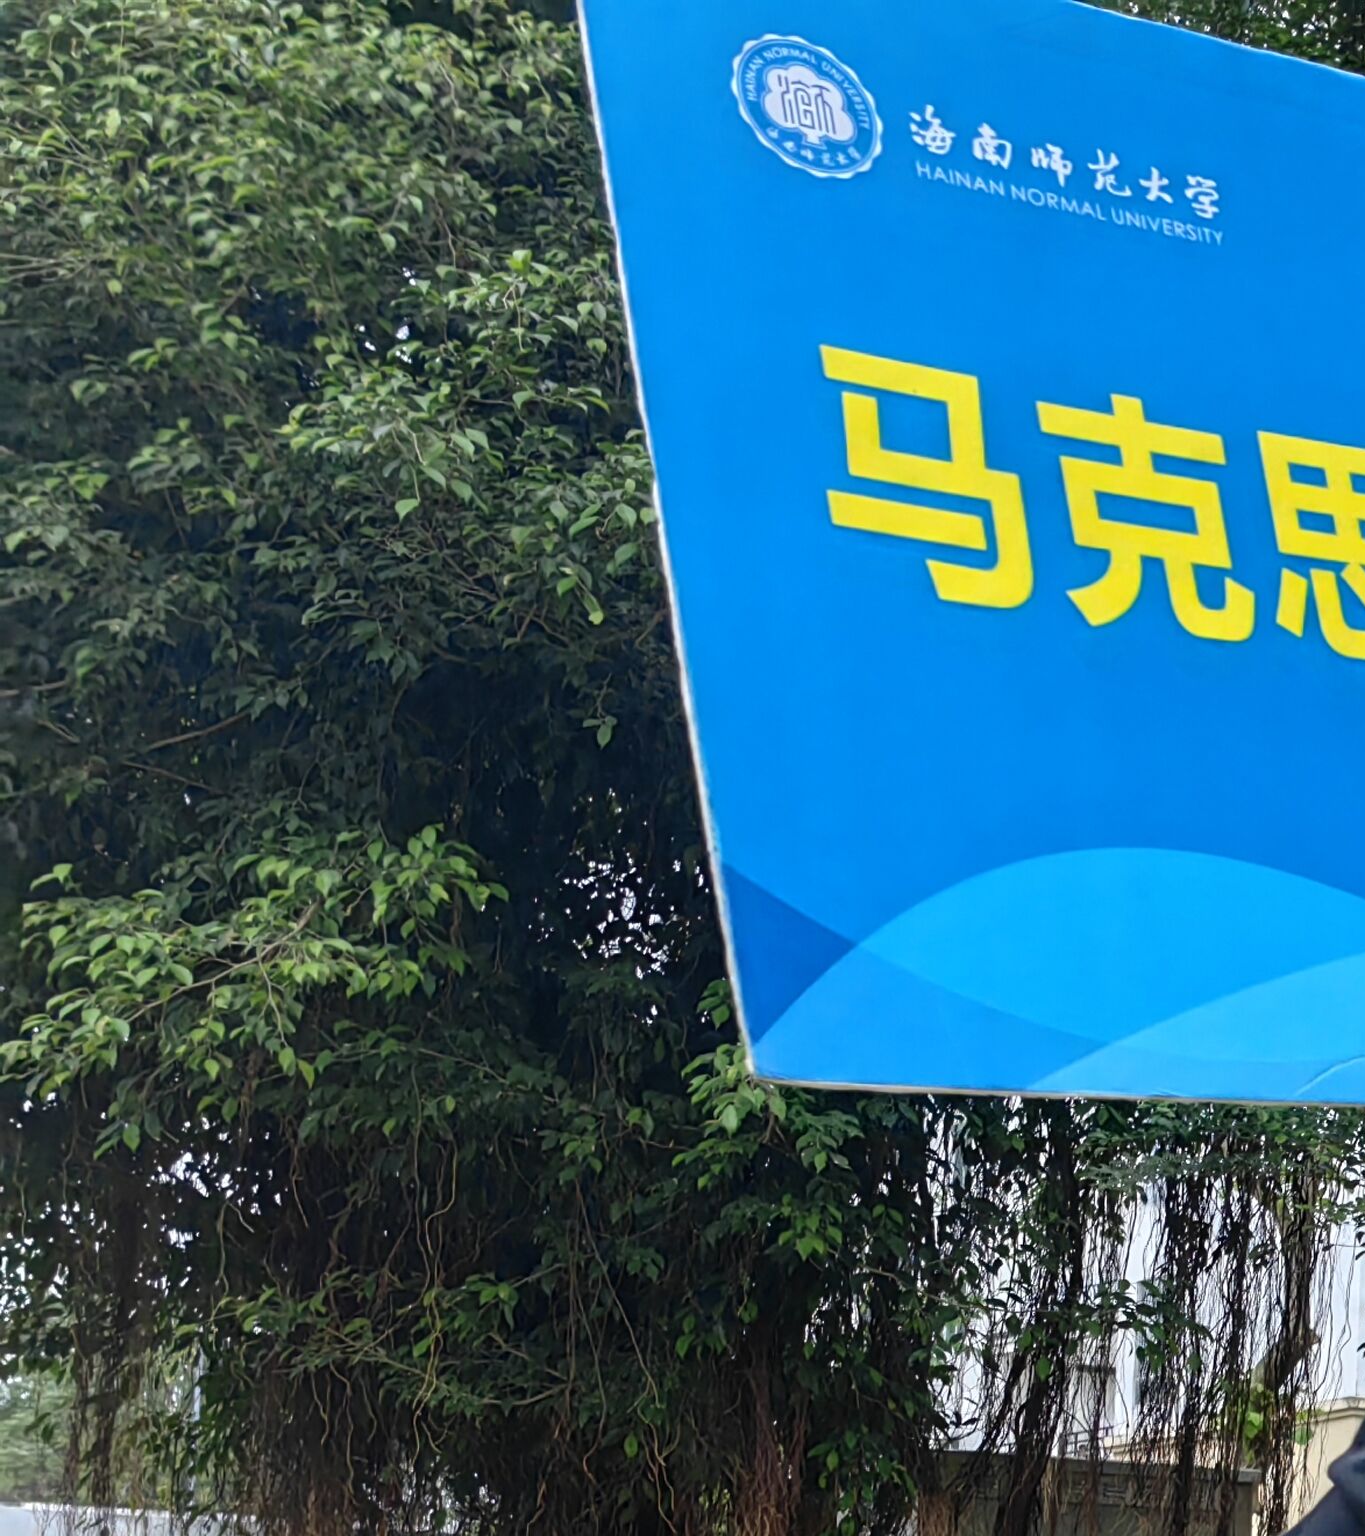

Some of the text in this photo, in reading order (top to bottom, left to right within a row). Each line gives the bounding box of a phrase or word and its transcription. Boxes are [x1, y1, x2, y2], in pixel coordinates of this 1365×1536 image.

[763, 46, 818, 65] NORMAL
[908, 104, 1221, 220] 海南师范大学
[915, 160, 1224, 247] HAINAN NORMAL UNIVERSITY
